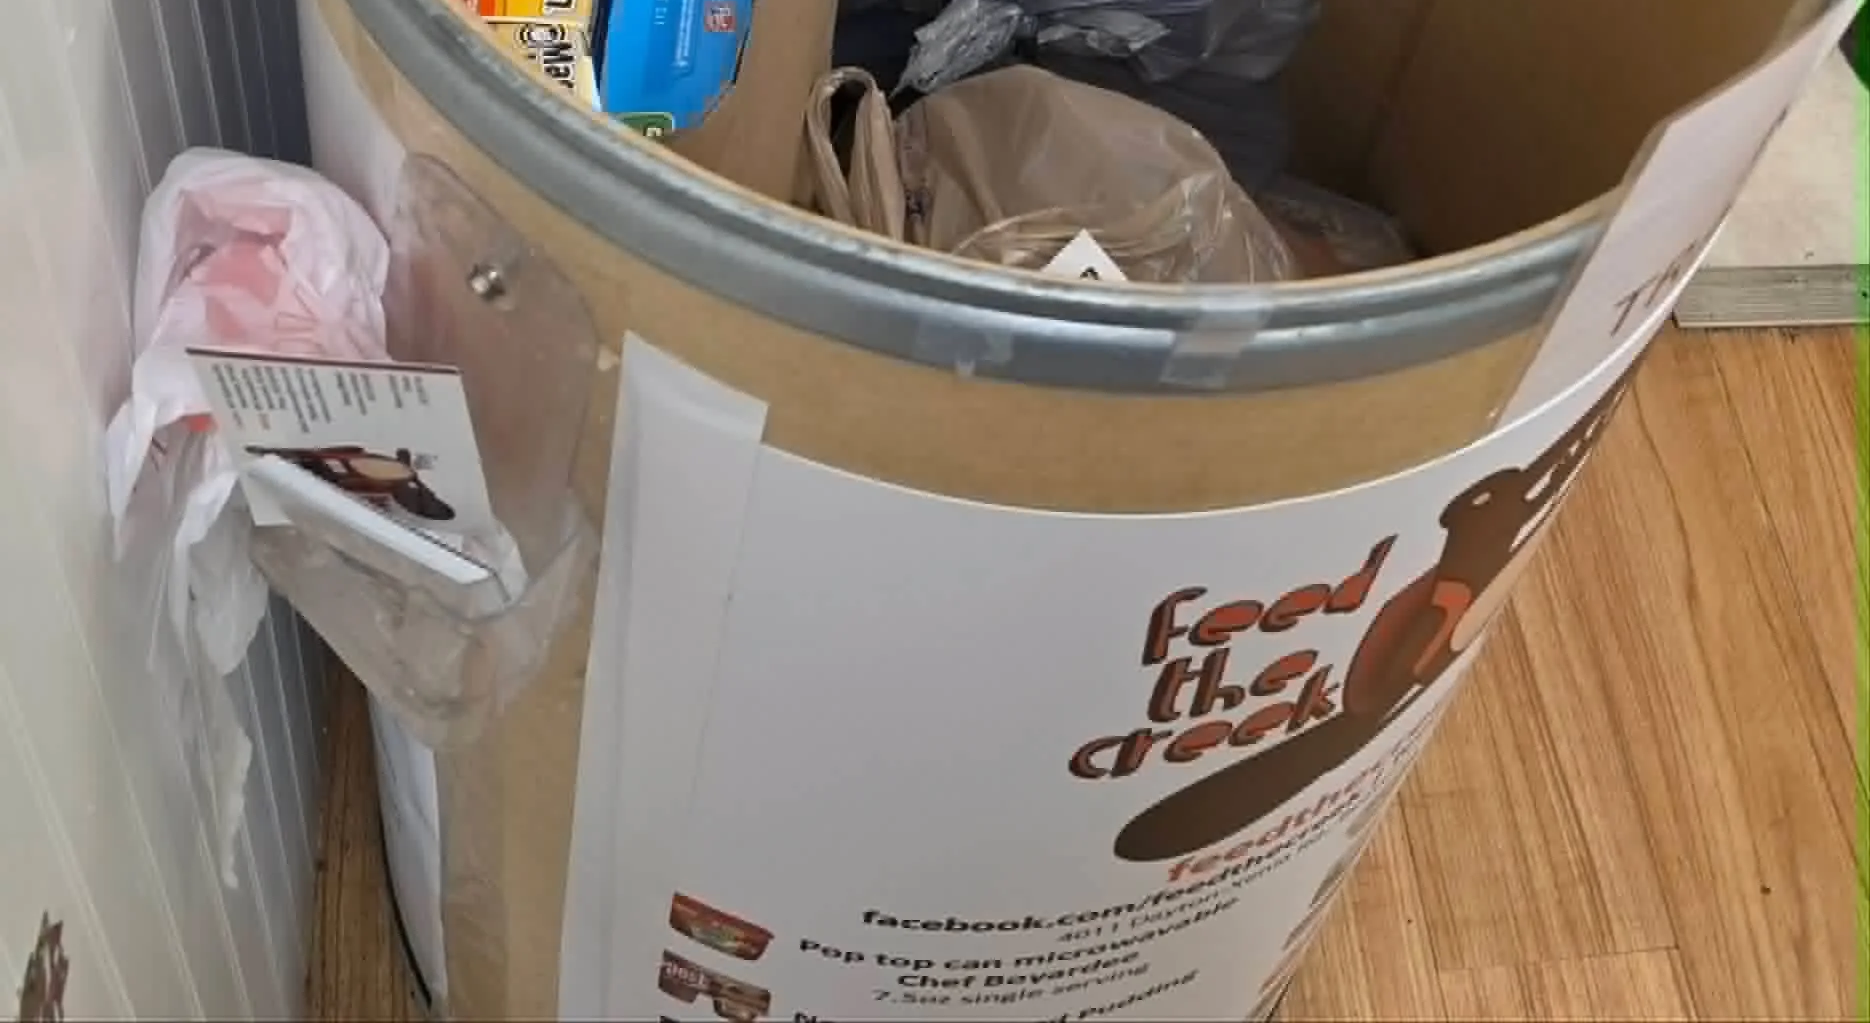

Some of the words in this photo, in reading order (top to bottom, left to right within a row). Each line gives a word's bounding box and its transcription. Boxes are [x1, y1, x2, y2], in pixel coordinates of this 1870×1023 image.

[1069, 664, 1339, 778] creek
[1148, 648, 1318, 723] the
[800, 938, 865, 964] Pop
[876, 954, 936, 971] top
[943, 959, 1002, 970] can
[1013, 897, 1240, 967] microwavable
[897, 975, 976, 988] Chef
